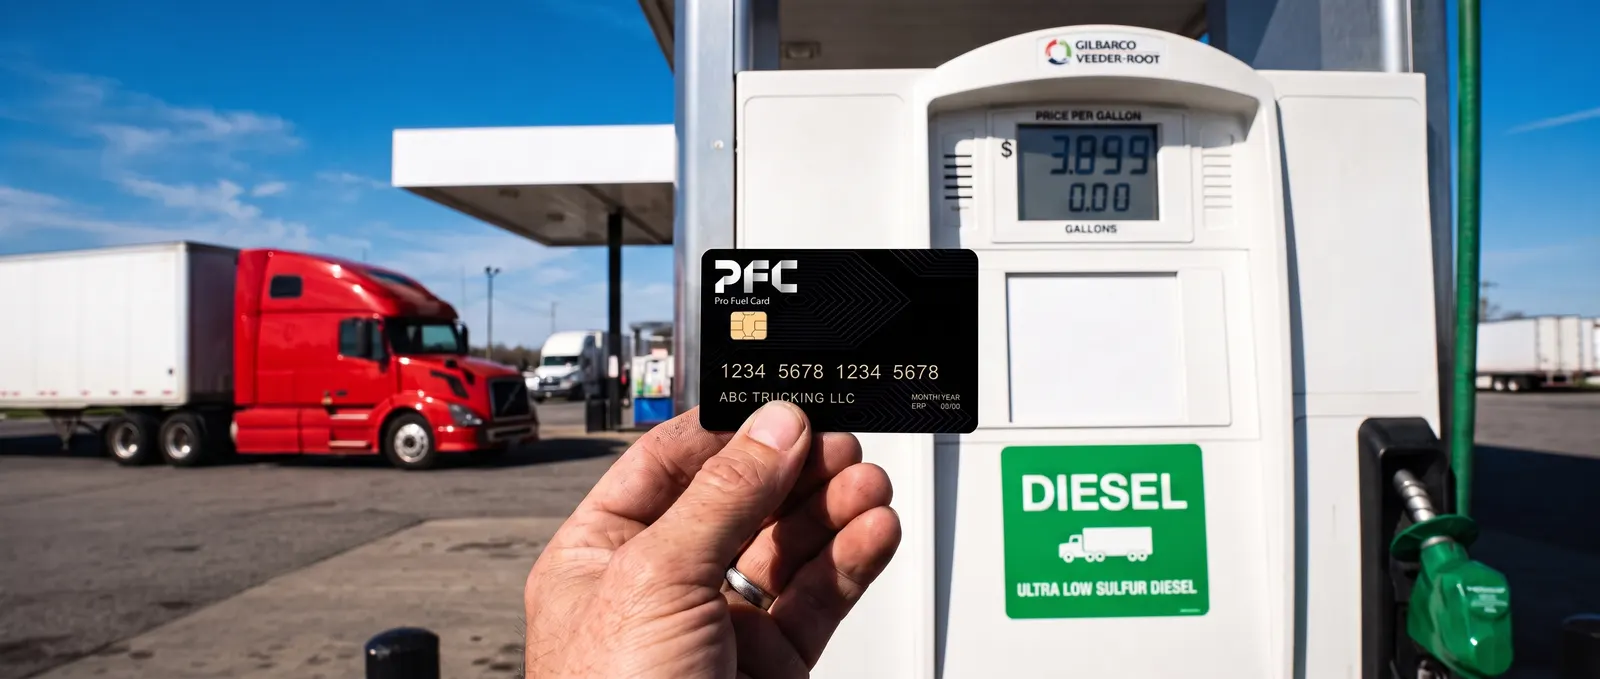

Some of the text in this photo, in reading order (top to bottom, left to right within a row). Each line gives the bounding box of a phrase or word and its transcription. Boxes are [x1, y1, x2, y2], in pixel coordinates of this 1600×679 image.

[1075, 40, 1137, 50] GILBARCO
[1076, 54, 1160, 64] VEEDER-ROOT
[1036, 110, 1142, 121] PRICE PER GALLON
[1001, 139, 1013, 158] $
[1050, 135, 1149, 175] 3.899
[1068, 182, 1131, 212] 0.00
[1065, 224, 1117, 234] GALLONS
[714, 259, 798, 294] PFC
[714, 296, 770, 305] Pro Fuel Card
[721, 363, 939, 380] 1234 5678 1234 5678
[719, 391, 855, 404] ABC TRUCKING LLC
[911, 402, 927, 410] ERP
[1021, 472, 1188, 512] DIESEL
[1016, 579, 1198, 597] ULTRA LOW SULFUR DIESEL
